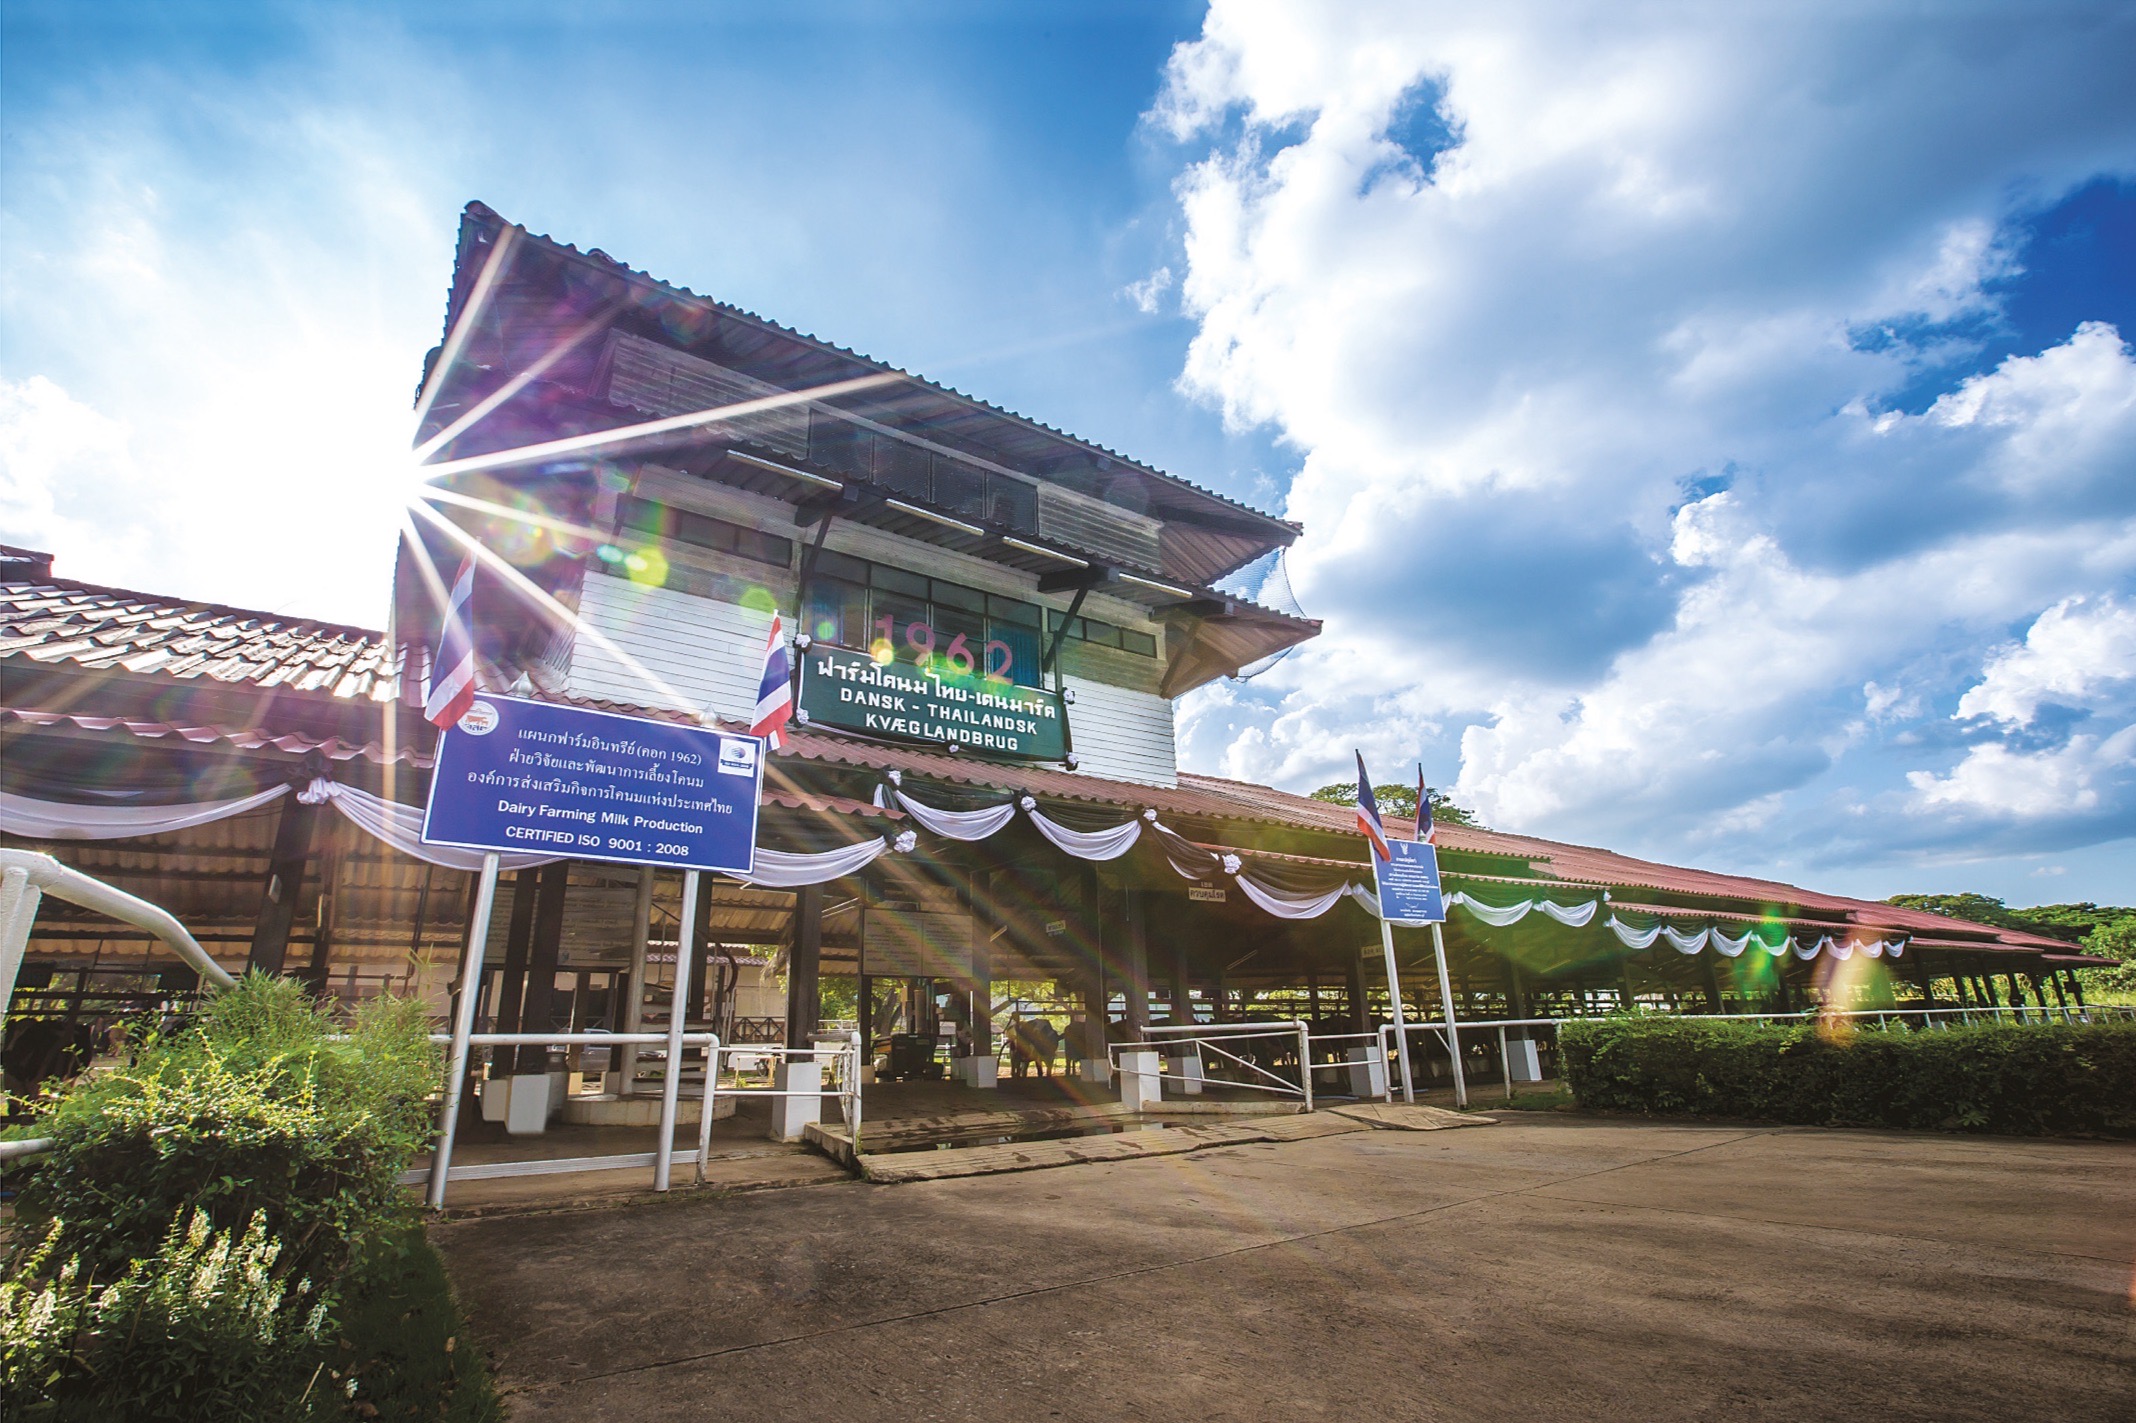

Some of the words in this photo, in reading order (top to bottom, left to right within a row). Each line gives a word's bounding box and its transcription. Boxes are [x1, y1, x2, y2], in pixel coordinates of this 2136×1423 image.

[876, 614, 1013, 685] 1962
[840, 688, 905, 711] DANSK
[927, 704, 1037, 735] THAILANDSK
[498, 800, 536, 817] Dairy
[539, 804, 596, 823] Farming
[601, 812, 629, 826] Milk
[634, 816, 703, 834] Production
[505, 826, 574, 844] CERTIFIED
[578, 834, 601, 847] ISO
[608, 838, 642, 852] 9001
[655, 843, 689, 856] 2008
